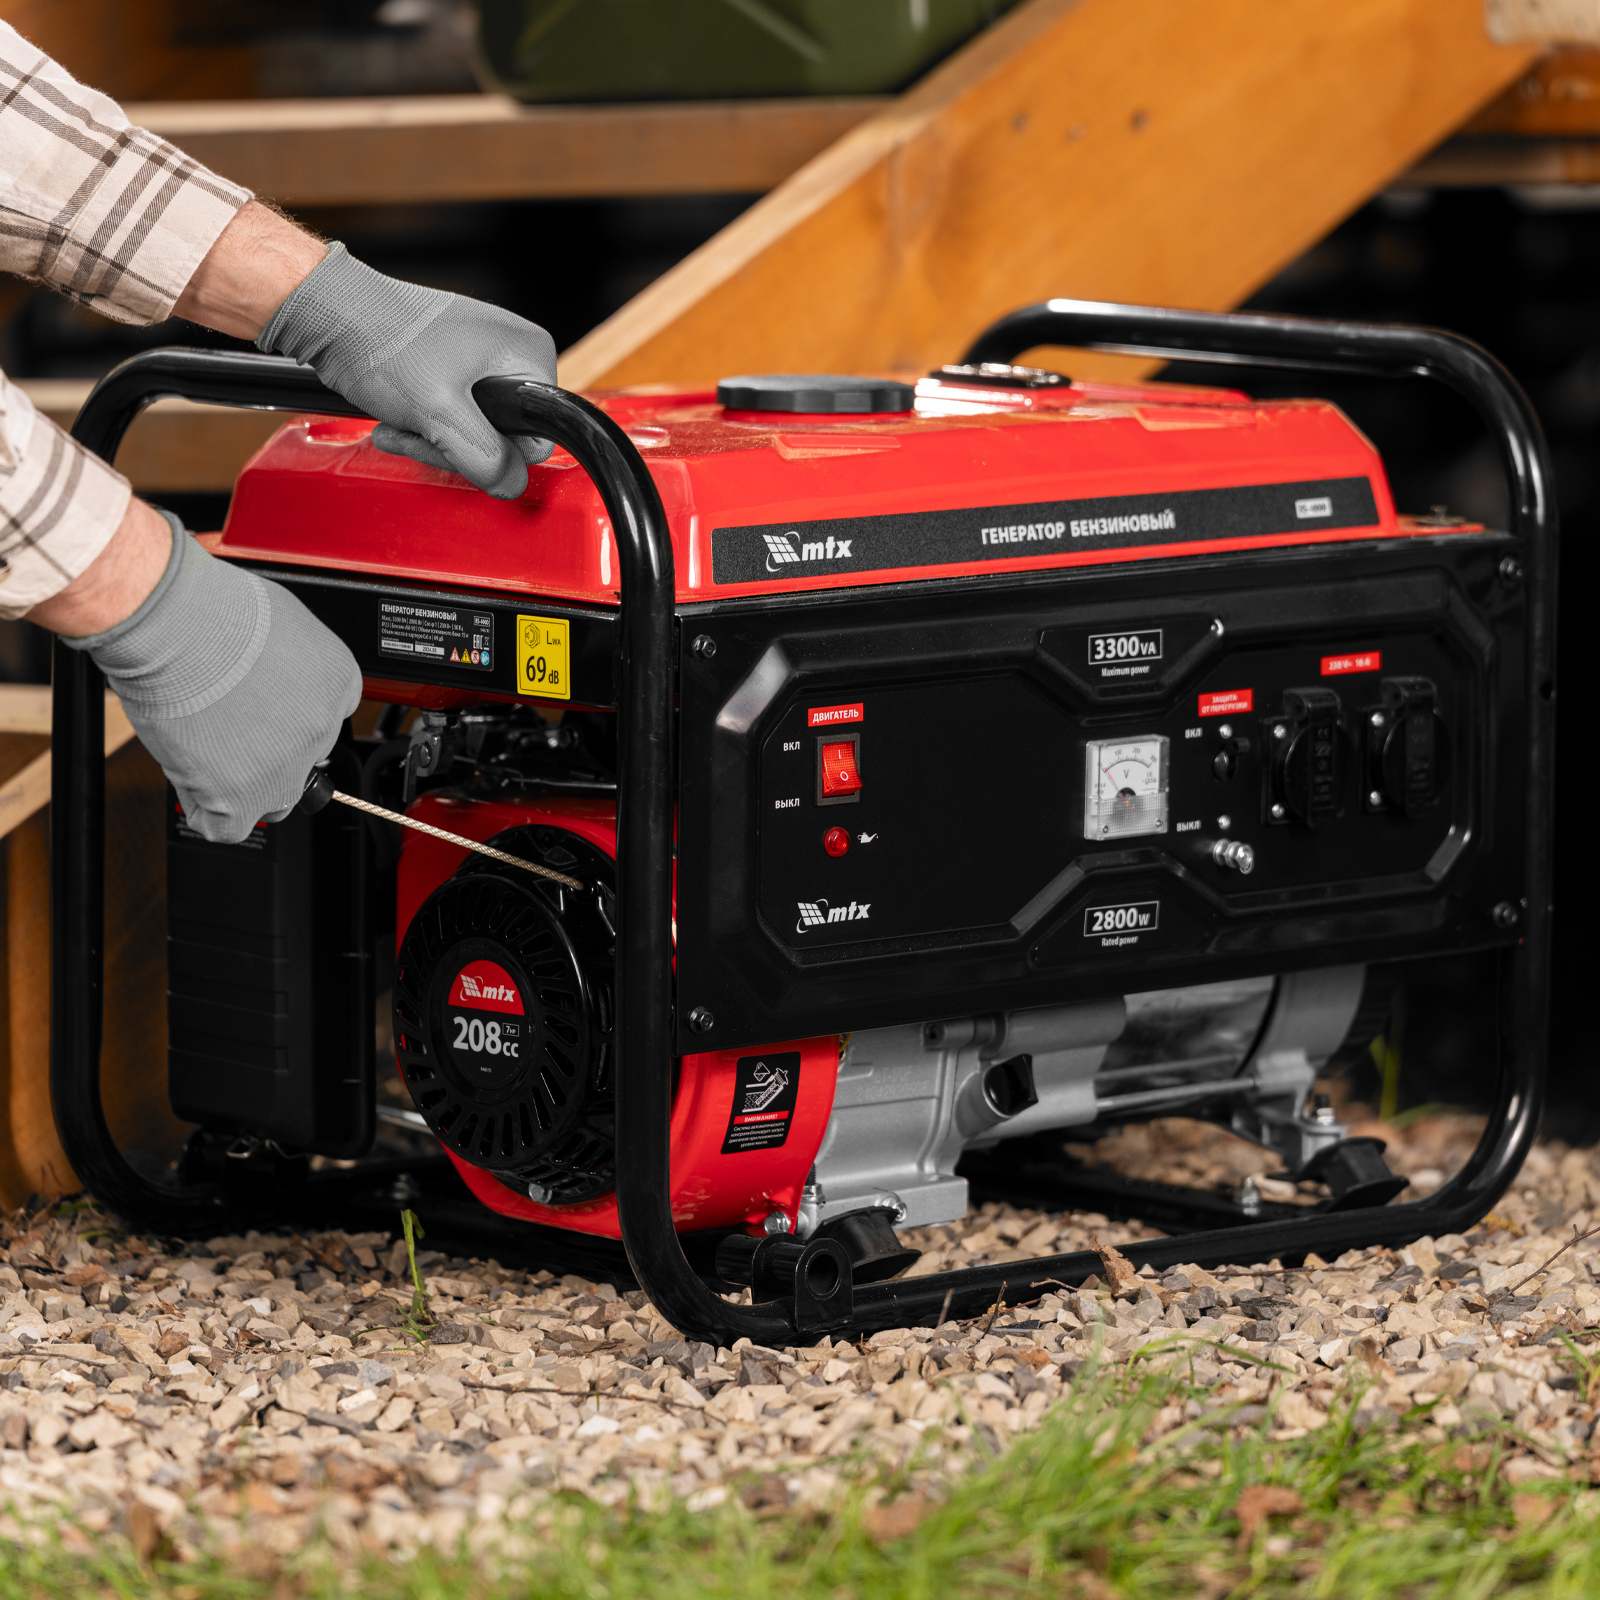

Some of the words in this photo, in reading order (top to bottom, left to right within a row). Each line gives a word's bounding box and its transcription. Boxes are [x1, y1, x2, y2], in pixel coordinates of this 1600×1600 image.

[981, 520, 1066, 545] ГЕНЕРАТОР
[1070, 508, 1176, 537] БЕНЗИНОВЫЙ
[801, 536, 853, 561] mtx
[381, 603, 415, 615] ГЕНЕРАТОР
[415, 608, 457, 621] БЕНЗИНОВЫЙ
[1094, 635, 1157, 660] 3300VA
[526, 655, 546, 683] 69
[548, 669, 559, 685] dB
[1101, 666, 1130, 677] Maximum
[1131, 665, 1150, 677] power
[1212, 694, 1238, 703] ЗАЩИТА
[1202, 705, 1210, 713] ОТ
[1210, 701, 1248, 712] ПЕРЕГРУЗКИ
[812, 709, 859, 724] ДВИГАТЕЛЬ
[1184, 727, 1203, 739] ВКЛ
[783, 741, 800, 751] ВКЛ
[1123, 769, 1129, 779] V
[775, 798, 800, 809] ВЫКЛ
[1176, 820, 1201, 832] ВЫКЛ
[827, 901, 871, 923] mtx
[1101, 936, 1119, 947] Rated
[1119, 935, 1139, 947] power
[482, 985, 515, 1002] mtx
[744, 1114, 778, 1122] ВНИМАНИЕ!
